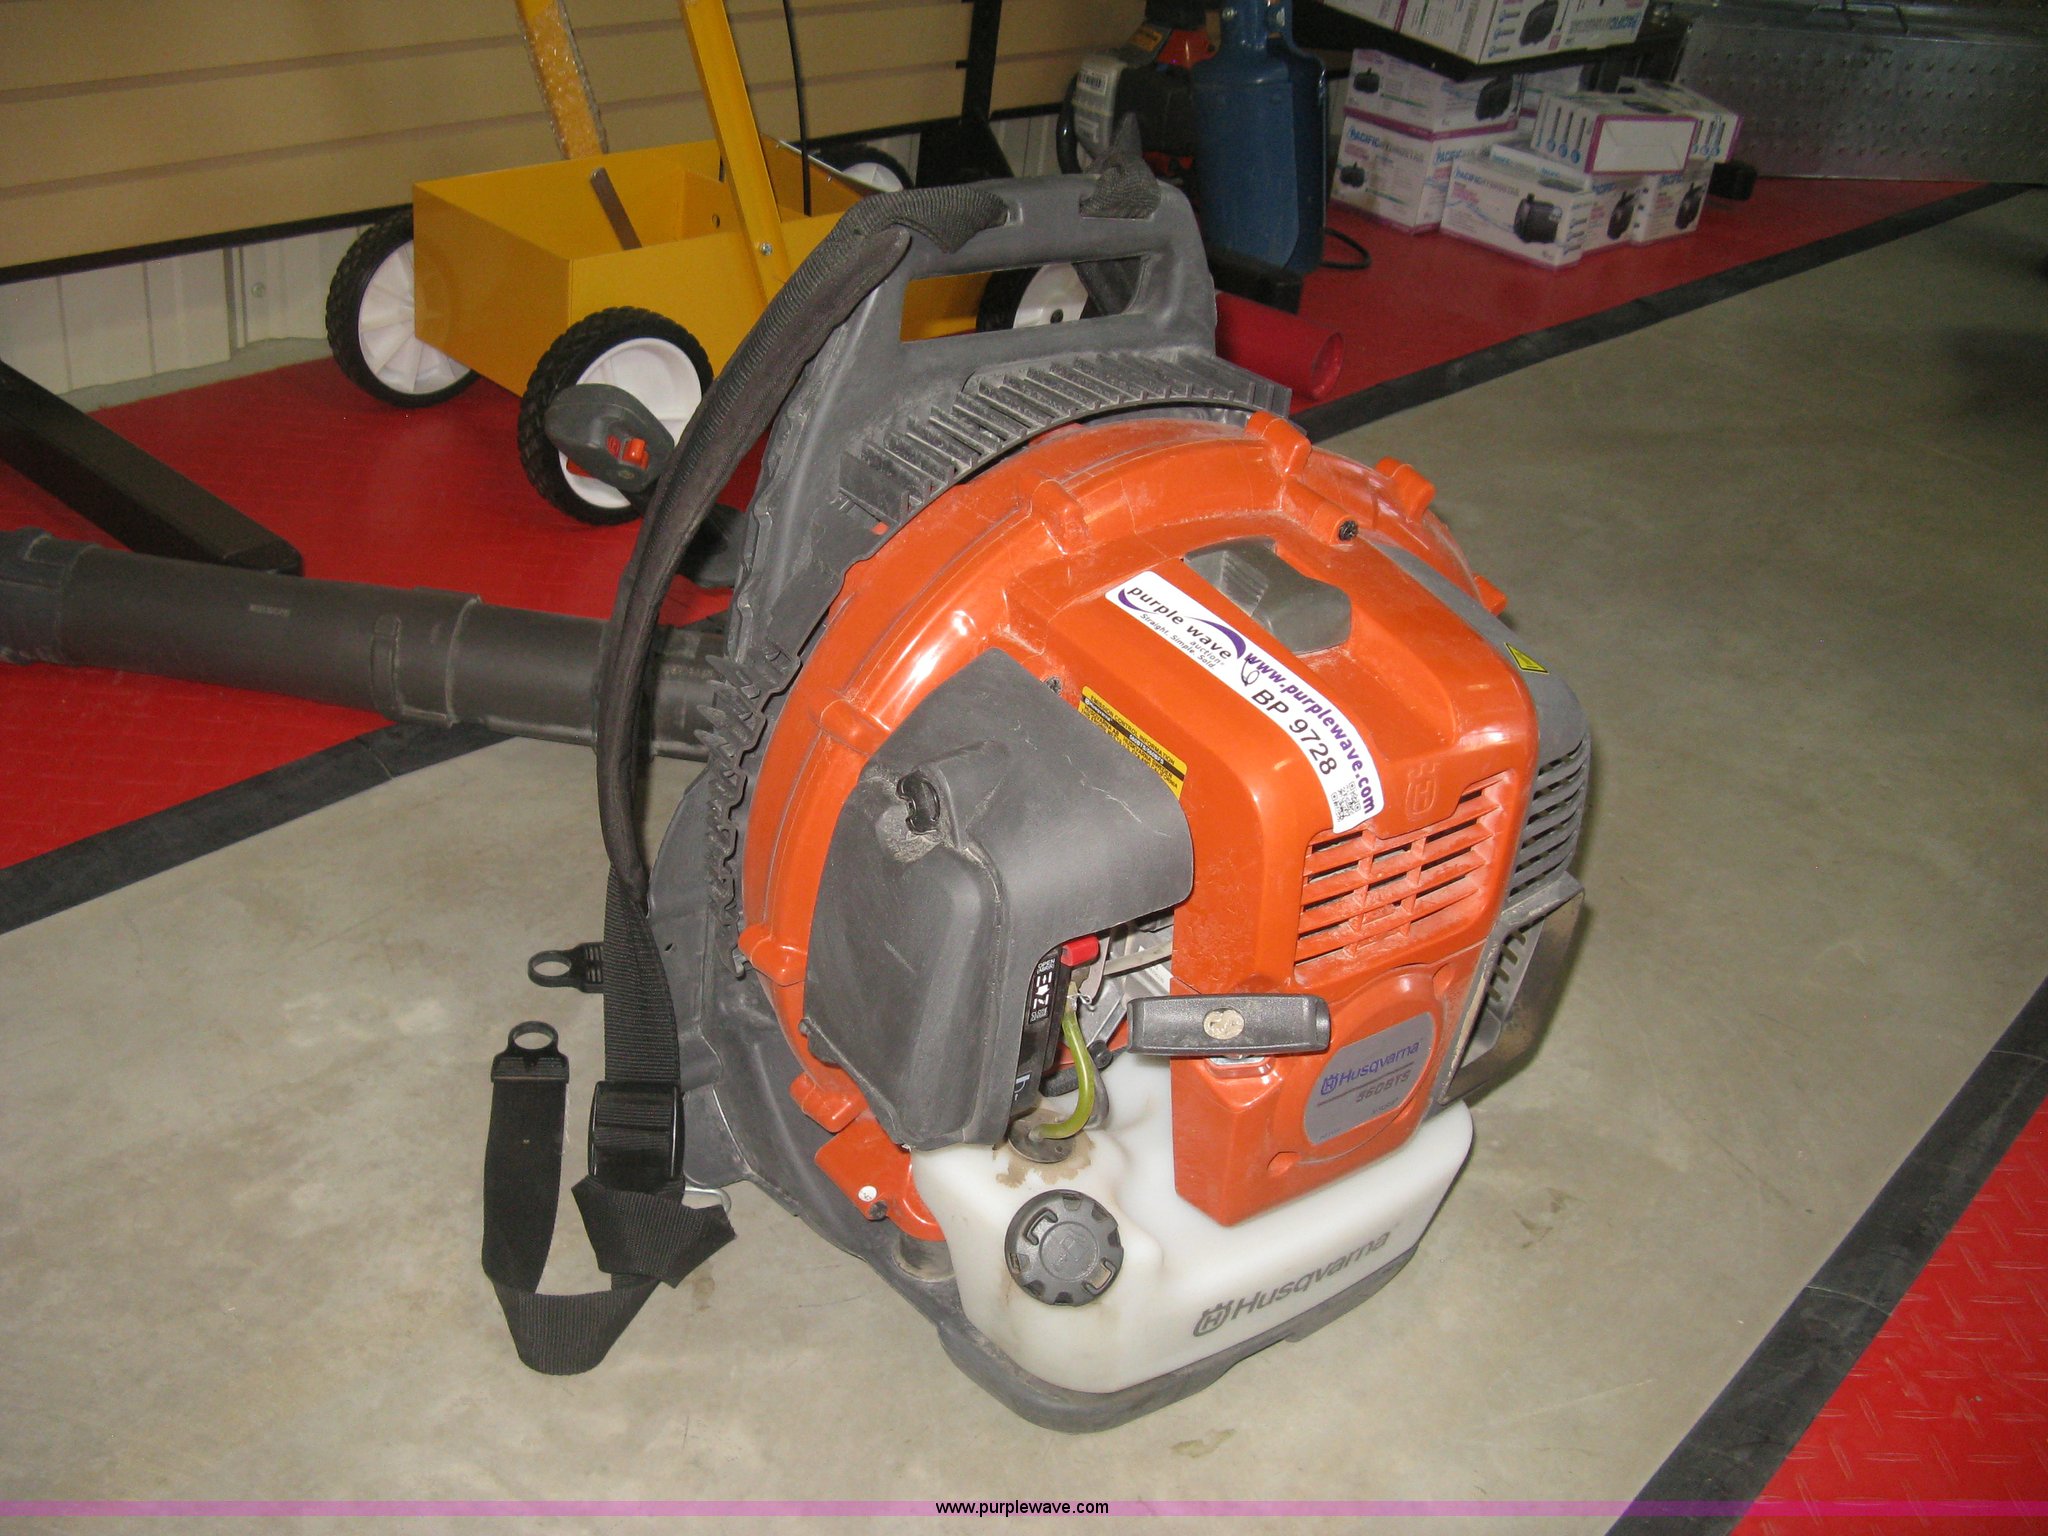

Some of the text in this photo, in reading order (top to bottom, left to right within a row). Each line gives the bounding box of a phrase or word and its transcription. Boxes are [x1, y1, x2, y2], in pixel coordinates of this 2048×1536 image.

[1127, 587, 1232, 660] purple wave
[1140, 613, 1216, 670] Straight. Simple. Sold.
[1113, 714, 1138, 735] CONTROL
[1138, 734, 1175, 764] INFORMATION
[1244, 653, 1375, 814] www.purplewave.com
[1251, 689, 1337, 775] BP 9728
[1339, 1042, 1420, 1086] Husqvarna
[1231, 1232, 1391, 1320] Husqvarna
